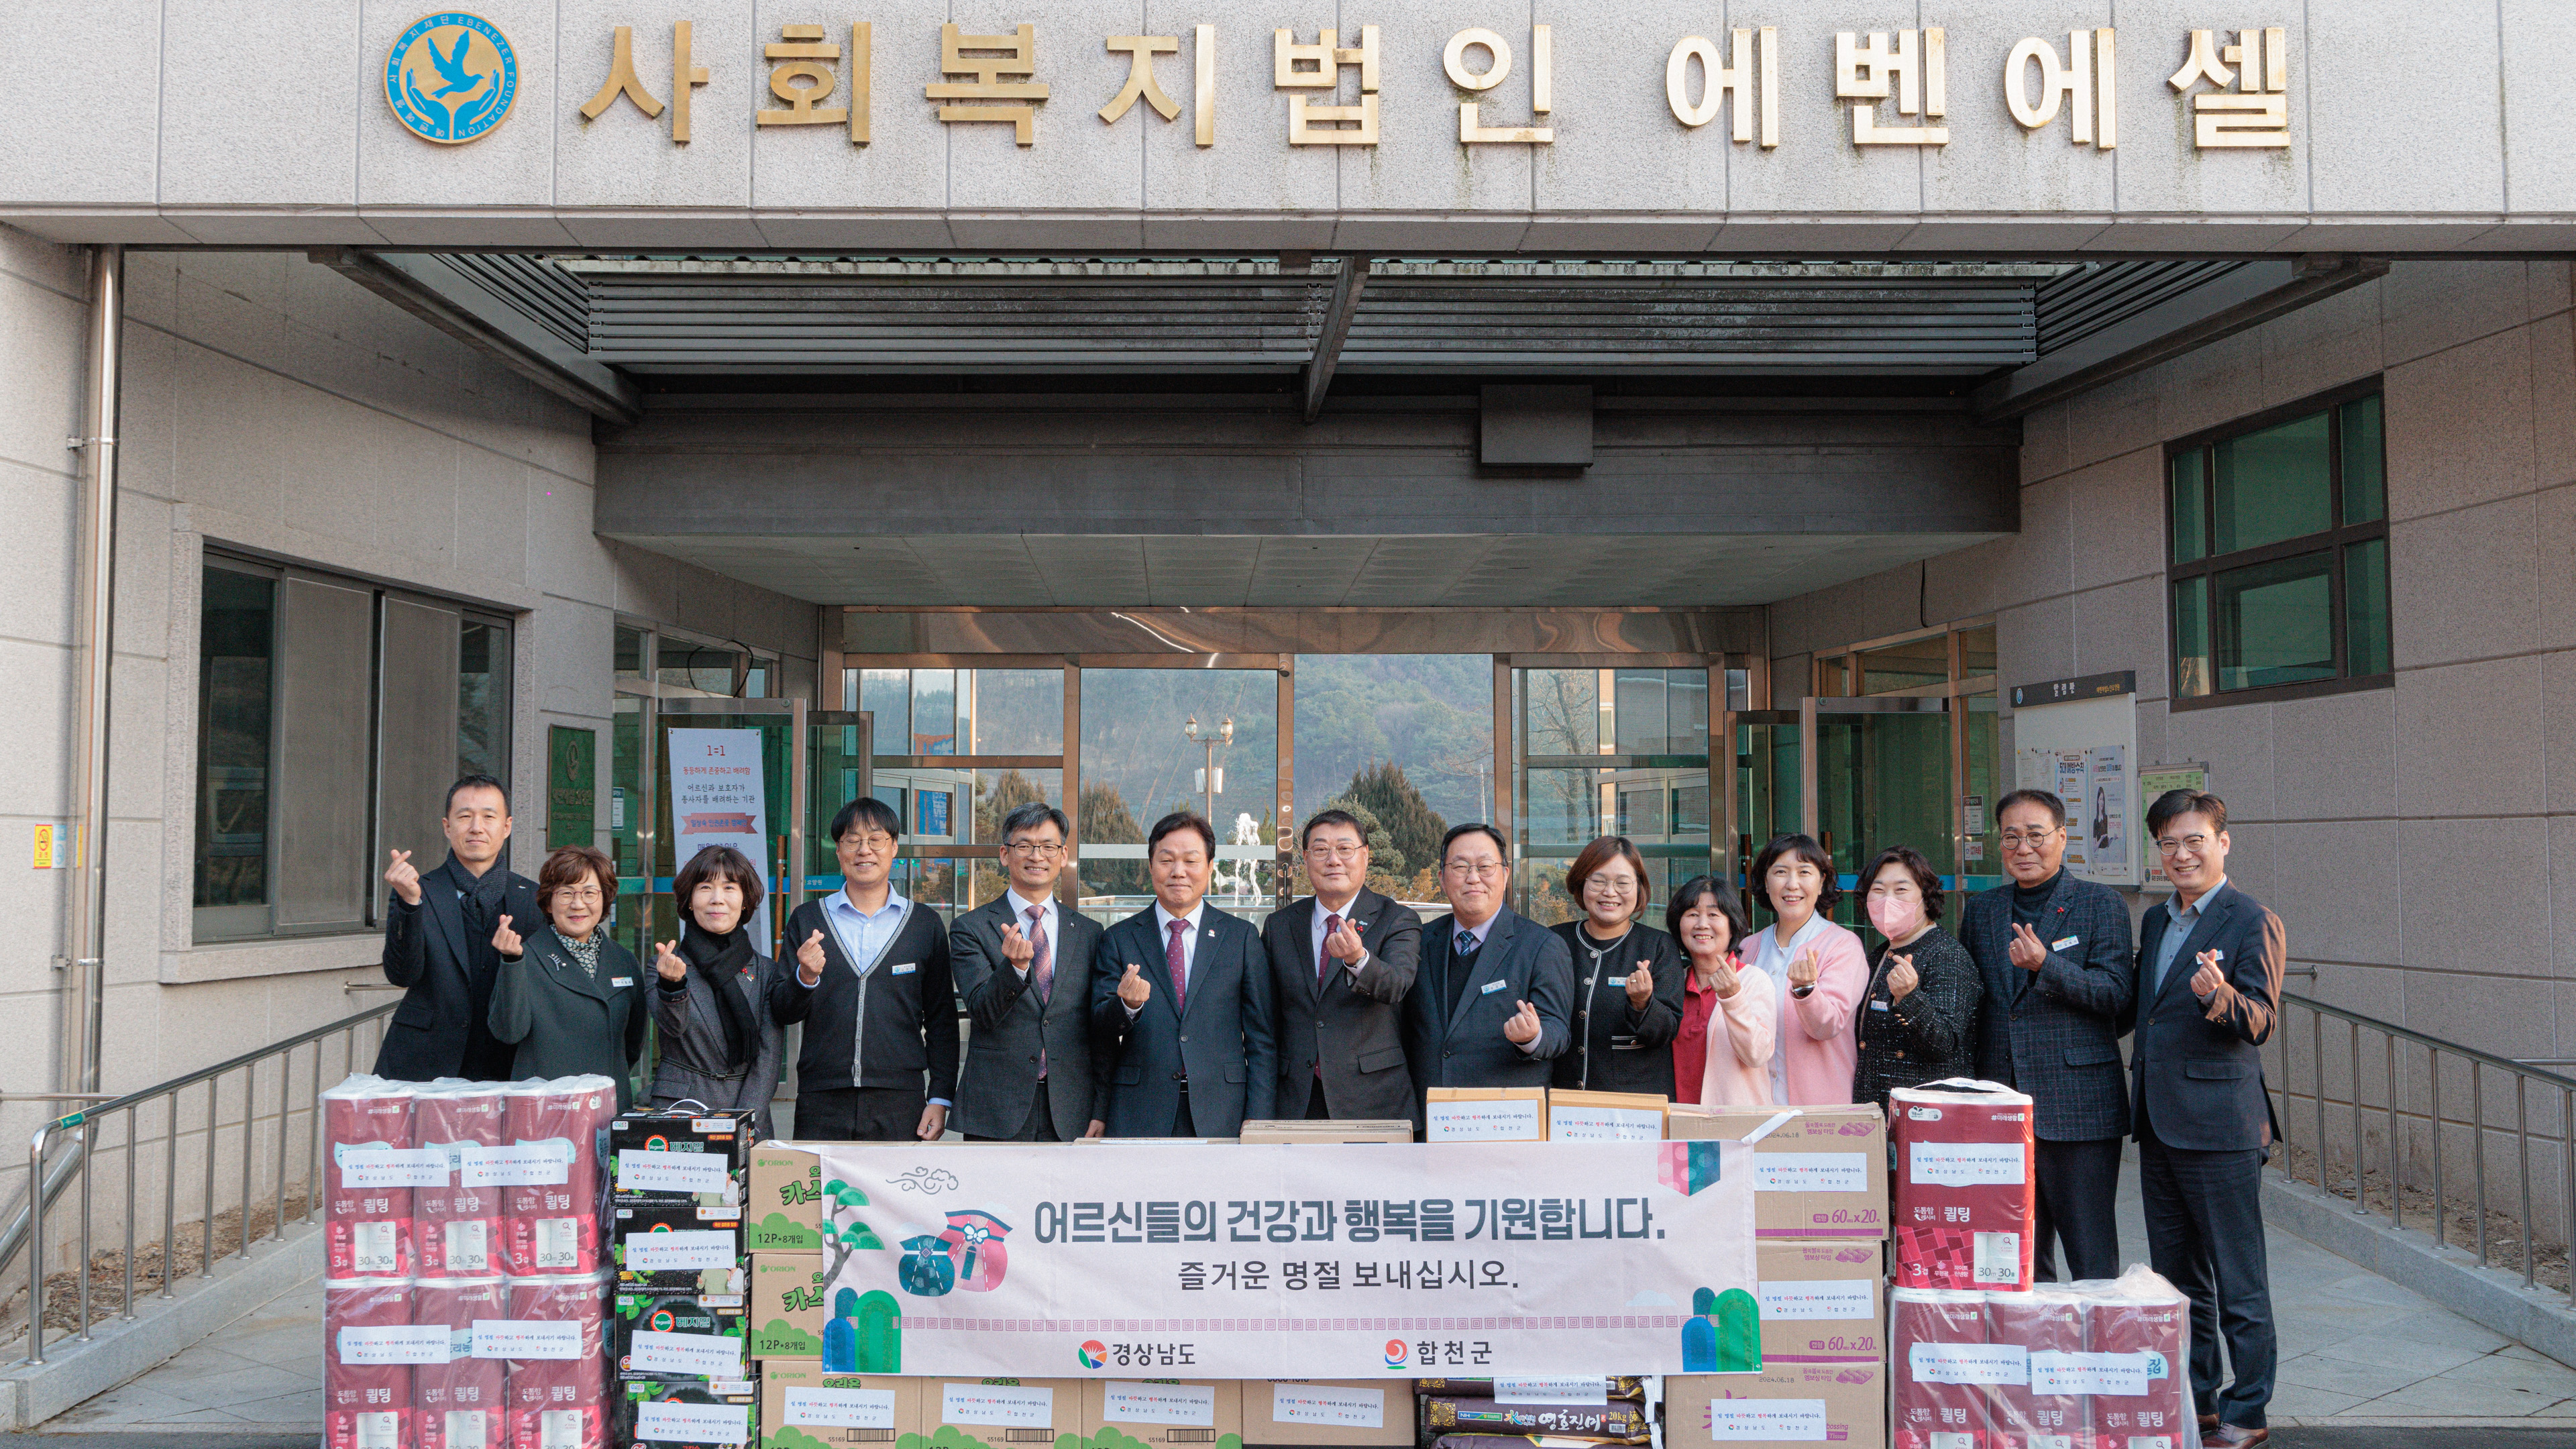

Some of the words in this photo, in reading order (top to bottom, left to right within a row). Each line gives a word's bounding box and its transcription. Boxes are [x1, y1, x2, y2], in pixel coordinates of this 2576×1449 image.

[458, 16, 513, 64] EBENEZER
[388, 15, 449, 83] 사회복지재단
[580, 20, 1554, 146] 사회복지법인
[1666, 25, 2290, 149] 에벤에셀
[458, 71, 515, 137] FOUNDATION
[2053, 682, 2075, 697] 알림판
[707, 745, 726, 756] 1=1
[683, 767, 706, 775] 동등하게
[708, 767, 731, 775] 존중하고
[733, 767, 751, 775] 배려함
[688, 784, 714, 792] 어르신과
[718, 784, 745, 792] 보호자가
[682, 795, 709, 804] 종사자를
[712, 795, 739, 804] 배려하는
[742, 795, 755, 804] 기관
[669, 1141, 704, 1152] 베지밀
[363, 1198, 388, 1213] 퀼팅
[453, 1197, 480, 1212] 퀼팅
[545, 1194, 570, 1210] 퀼팅
[1913, 1207, 1934, 1215] 도톰함
[1943, 1207, 1970, 1222] 퀼팅
[1034, 1199, 1216, 1243] 어르신들의
[1227, 1199, 1338, 1243] 건강과
[1344, 1198, 1455, 1242] 행복을
[1464, 1197, 1665, 1240] 기원합니다.
[333, 1255, 347, 1267] 3겹
[425, 1254, 439, 1266] 3겹
[515, 1252, 529, 1265] 3겹
[1178, 1260, 1269, 1291] 즐거운
[1283, 1260, 1341, 1291] 명절
[1352, 1260, 1518, 1289] 보내십시오.
[1913, 1263, 1929, 1276] 3겹
[676, 1317, 711, 1328] 베지밀
[1112, 1343, 1195, 1366] 경상남도
[1417, 1340, 1492, 1366] 합천군
[822, 1377, 861, 1389] 오리온
[366, 1387, 391, 1403] 퀼팅
[1609, 1411, 1627, 1423] 20kg
[1909, 1408, 1931, 1416] 도톰함
[1939, 1407, 1966, 1424] 퀼팅
[2037, 1409, 2063, 1426] 퀼팅
[2137, 1411, 2163, 1427] 퀼팅
[1538, 1409, 1601, 1432] 영호진미
